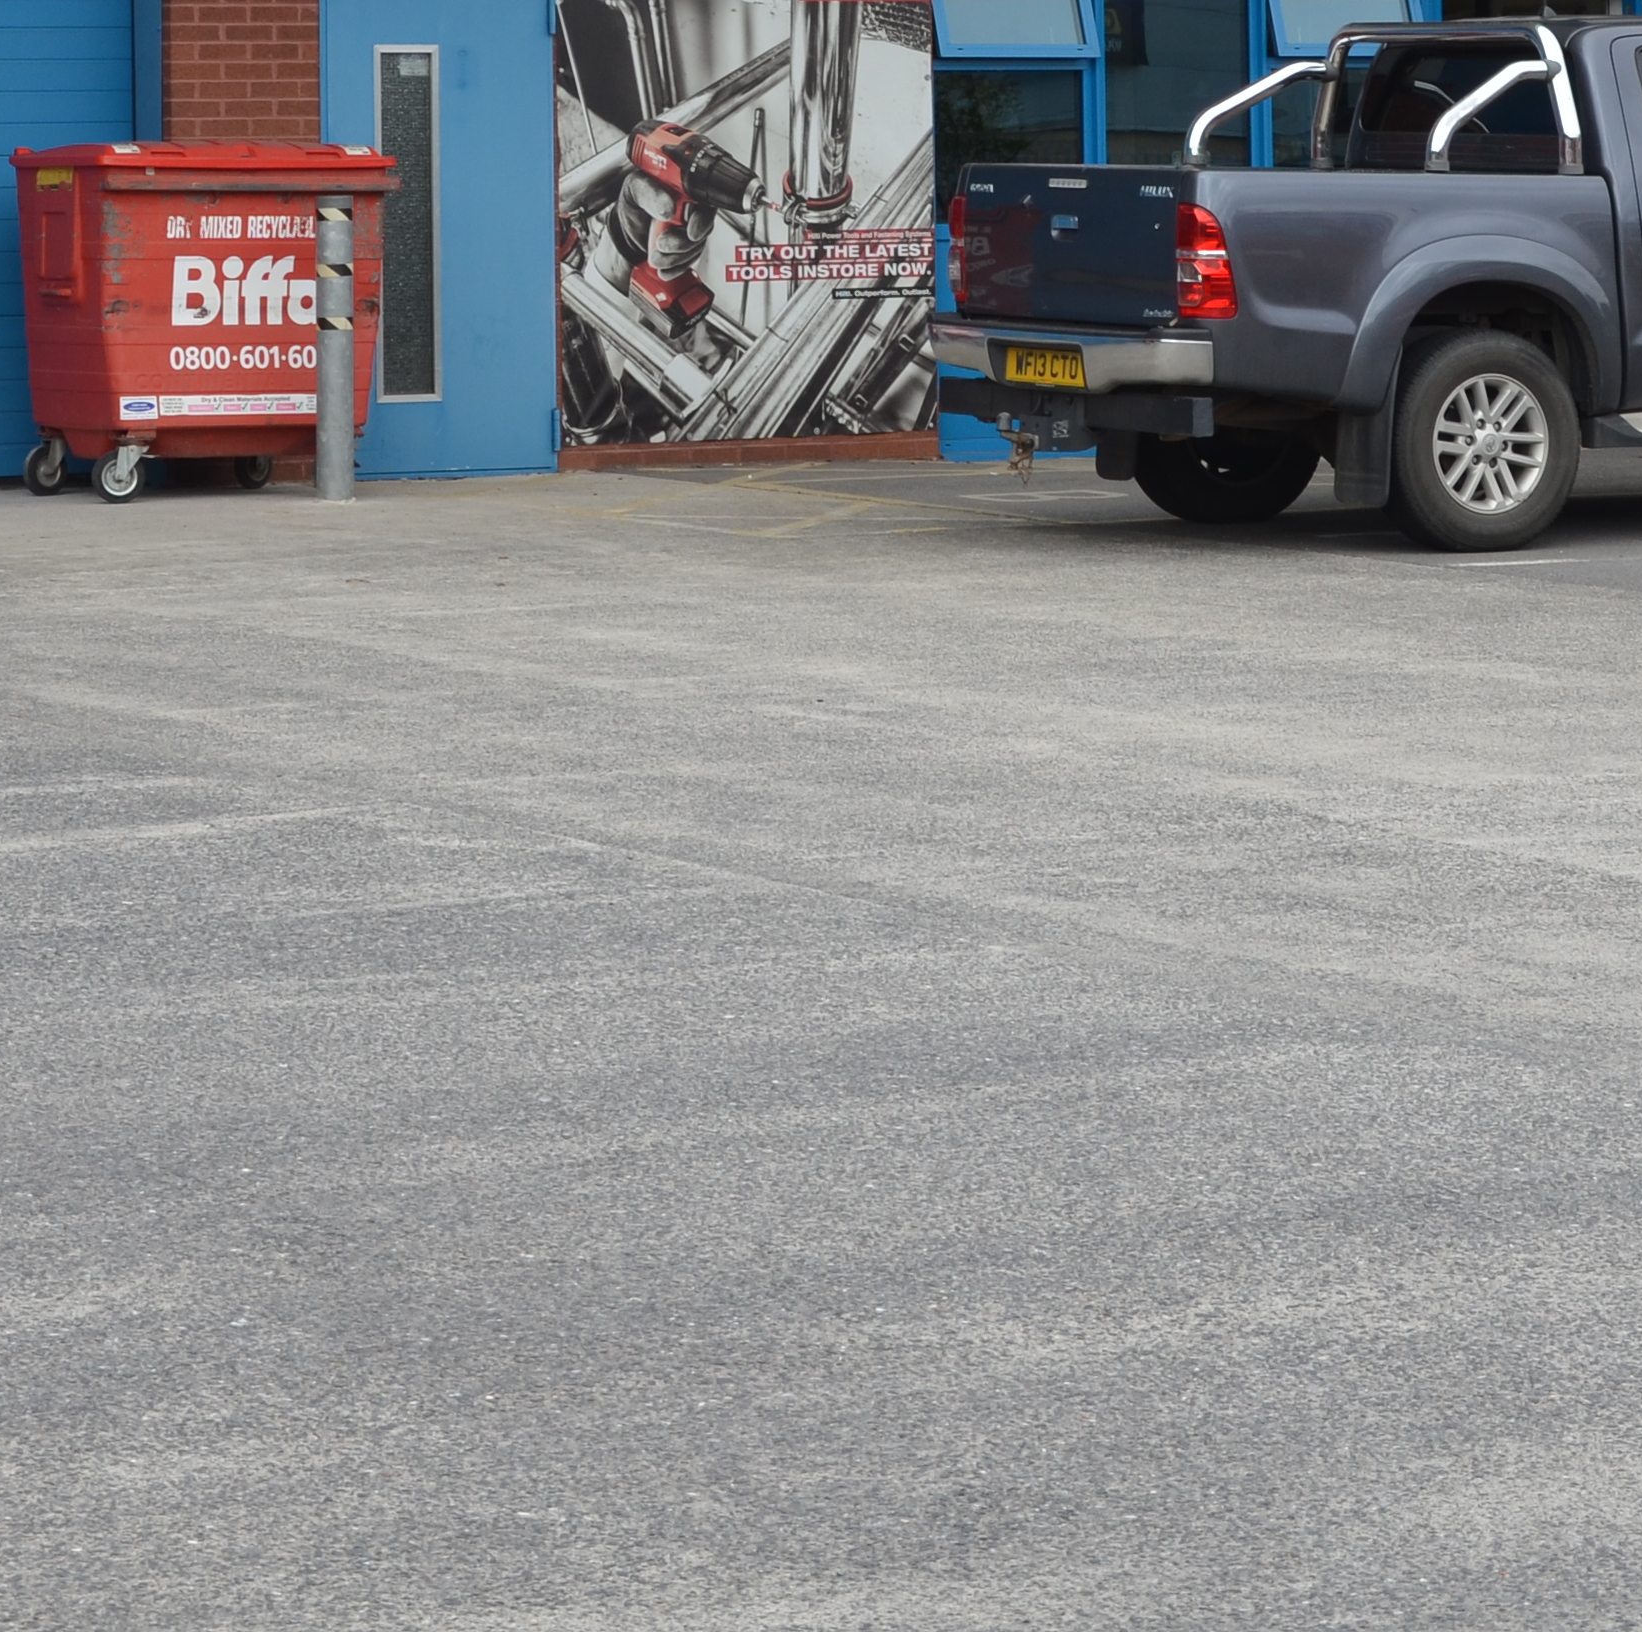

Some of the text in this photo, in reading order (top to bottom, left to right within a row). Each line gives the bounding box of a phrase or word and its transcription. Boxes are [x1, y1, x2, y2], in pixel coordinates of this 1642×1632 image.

[200, 215, 243, 239] MIXED
[738, 243, 932, 260] TRY OUT THE LATEST
[728, 262, 932, 280] TOOLS INSTORE NOW.
[171, 255, 317, 327] Biffa
[1015, 351, 1079, 380] WF13 CTO
